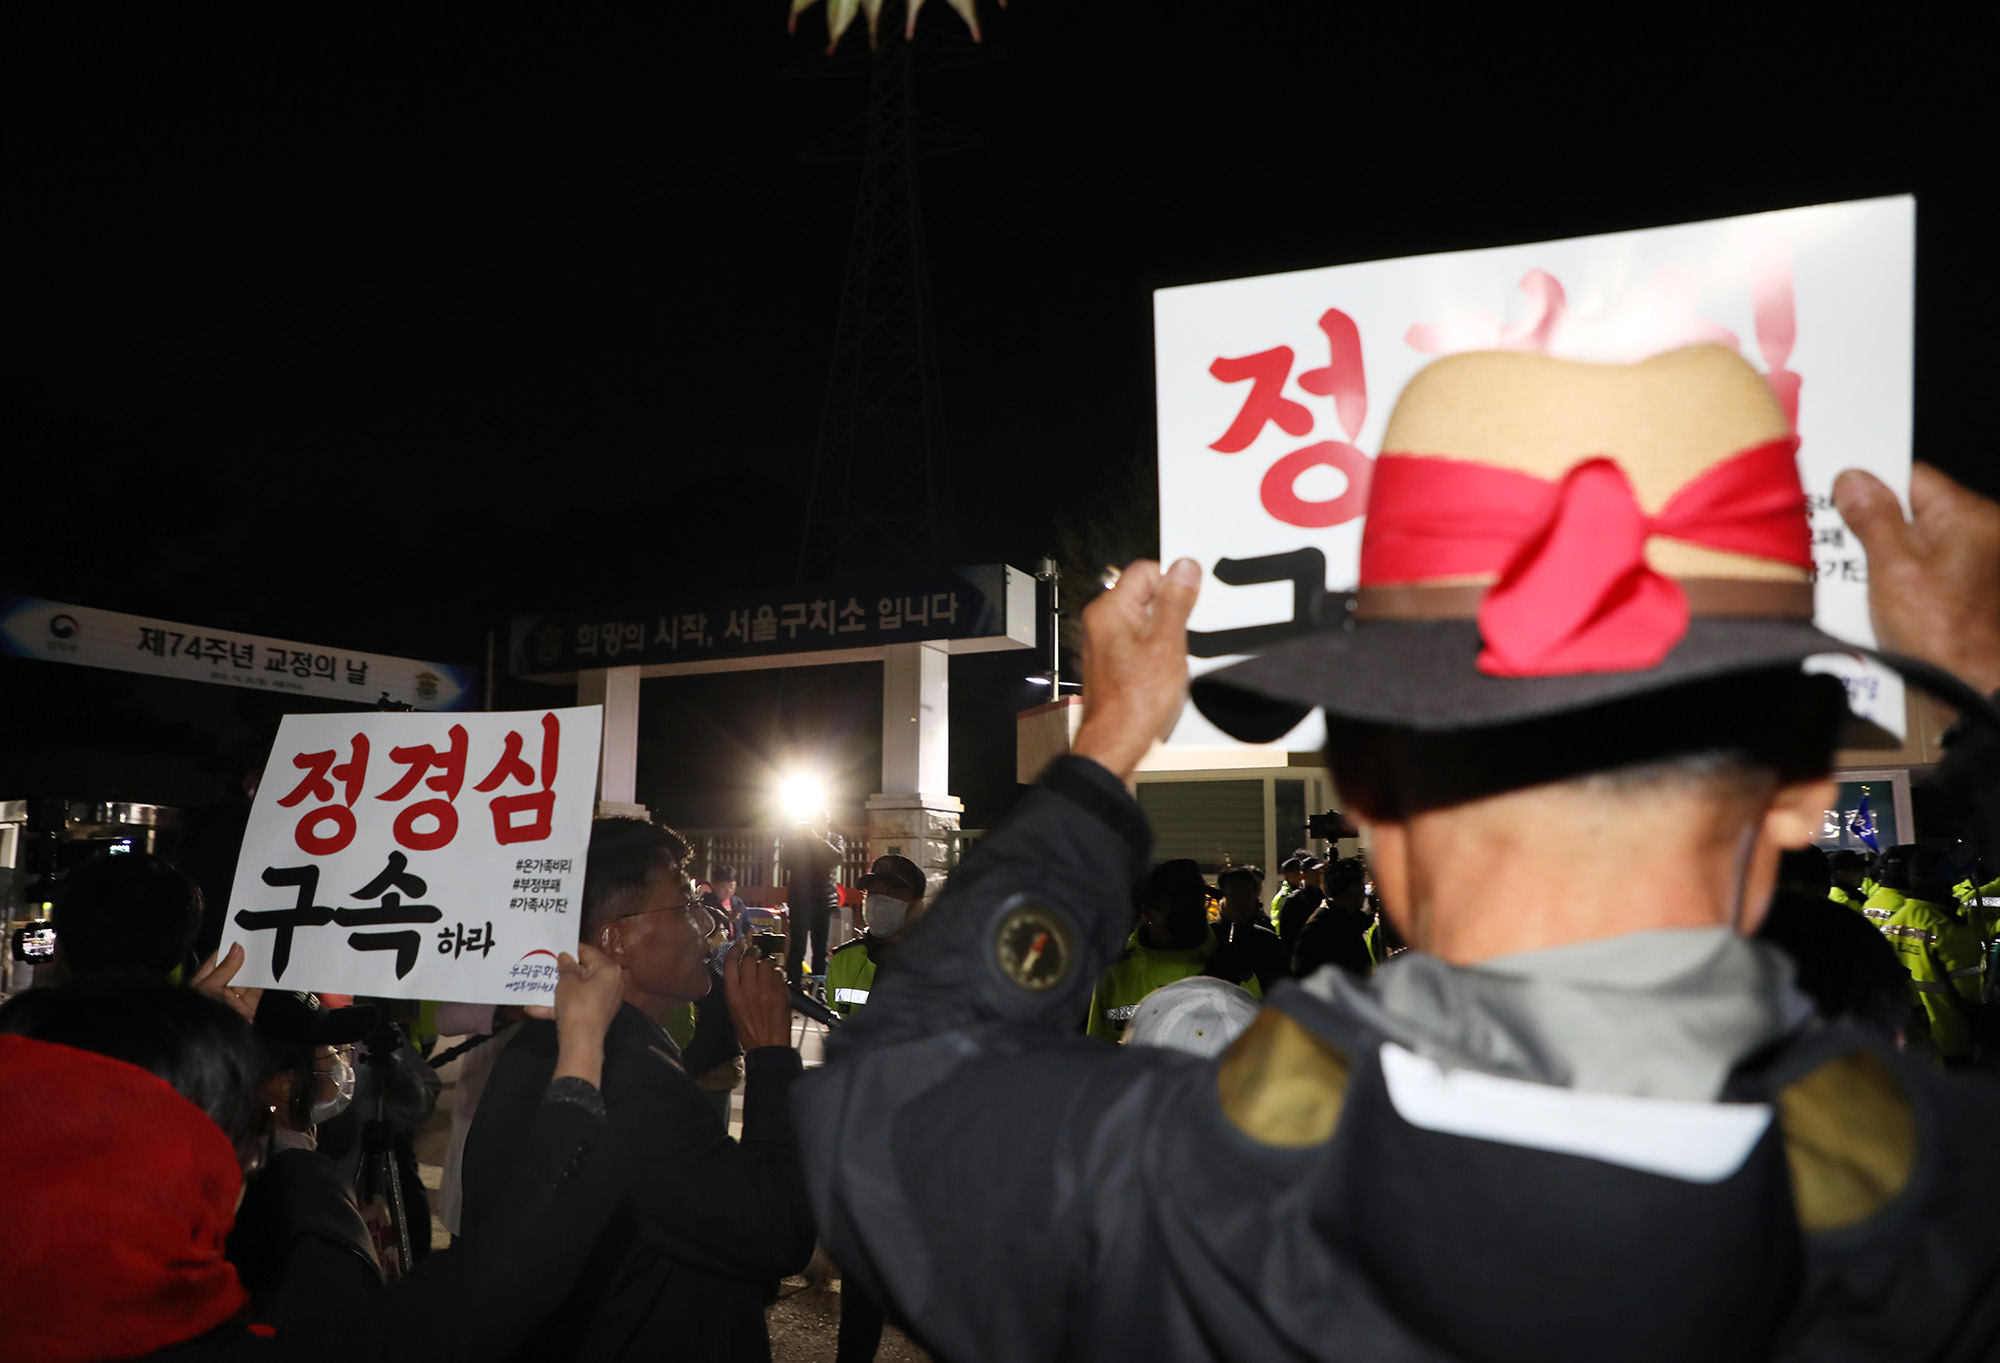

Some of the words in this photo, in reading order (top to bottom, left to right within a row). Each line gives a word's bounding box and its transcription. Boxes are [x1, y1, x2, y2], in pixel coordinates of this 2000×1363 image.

[576, 621, 645, 657] 희망의
[723, 597, 867, 644] 서울구치소
[878, 592, 959, 630] 입니다
[137, 626, 256, 671] 제74주년
[264, 647, 338, 682] 교정의
[346, 660, 370, 686] 날
[277, 712, 560, 856] 정경심
[509, 896, 569, 914] #가족사기단
[512, 877, 562, 894] #부정부패
